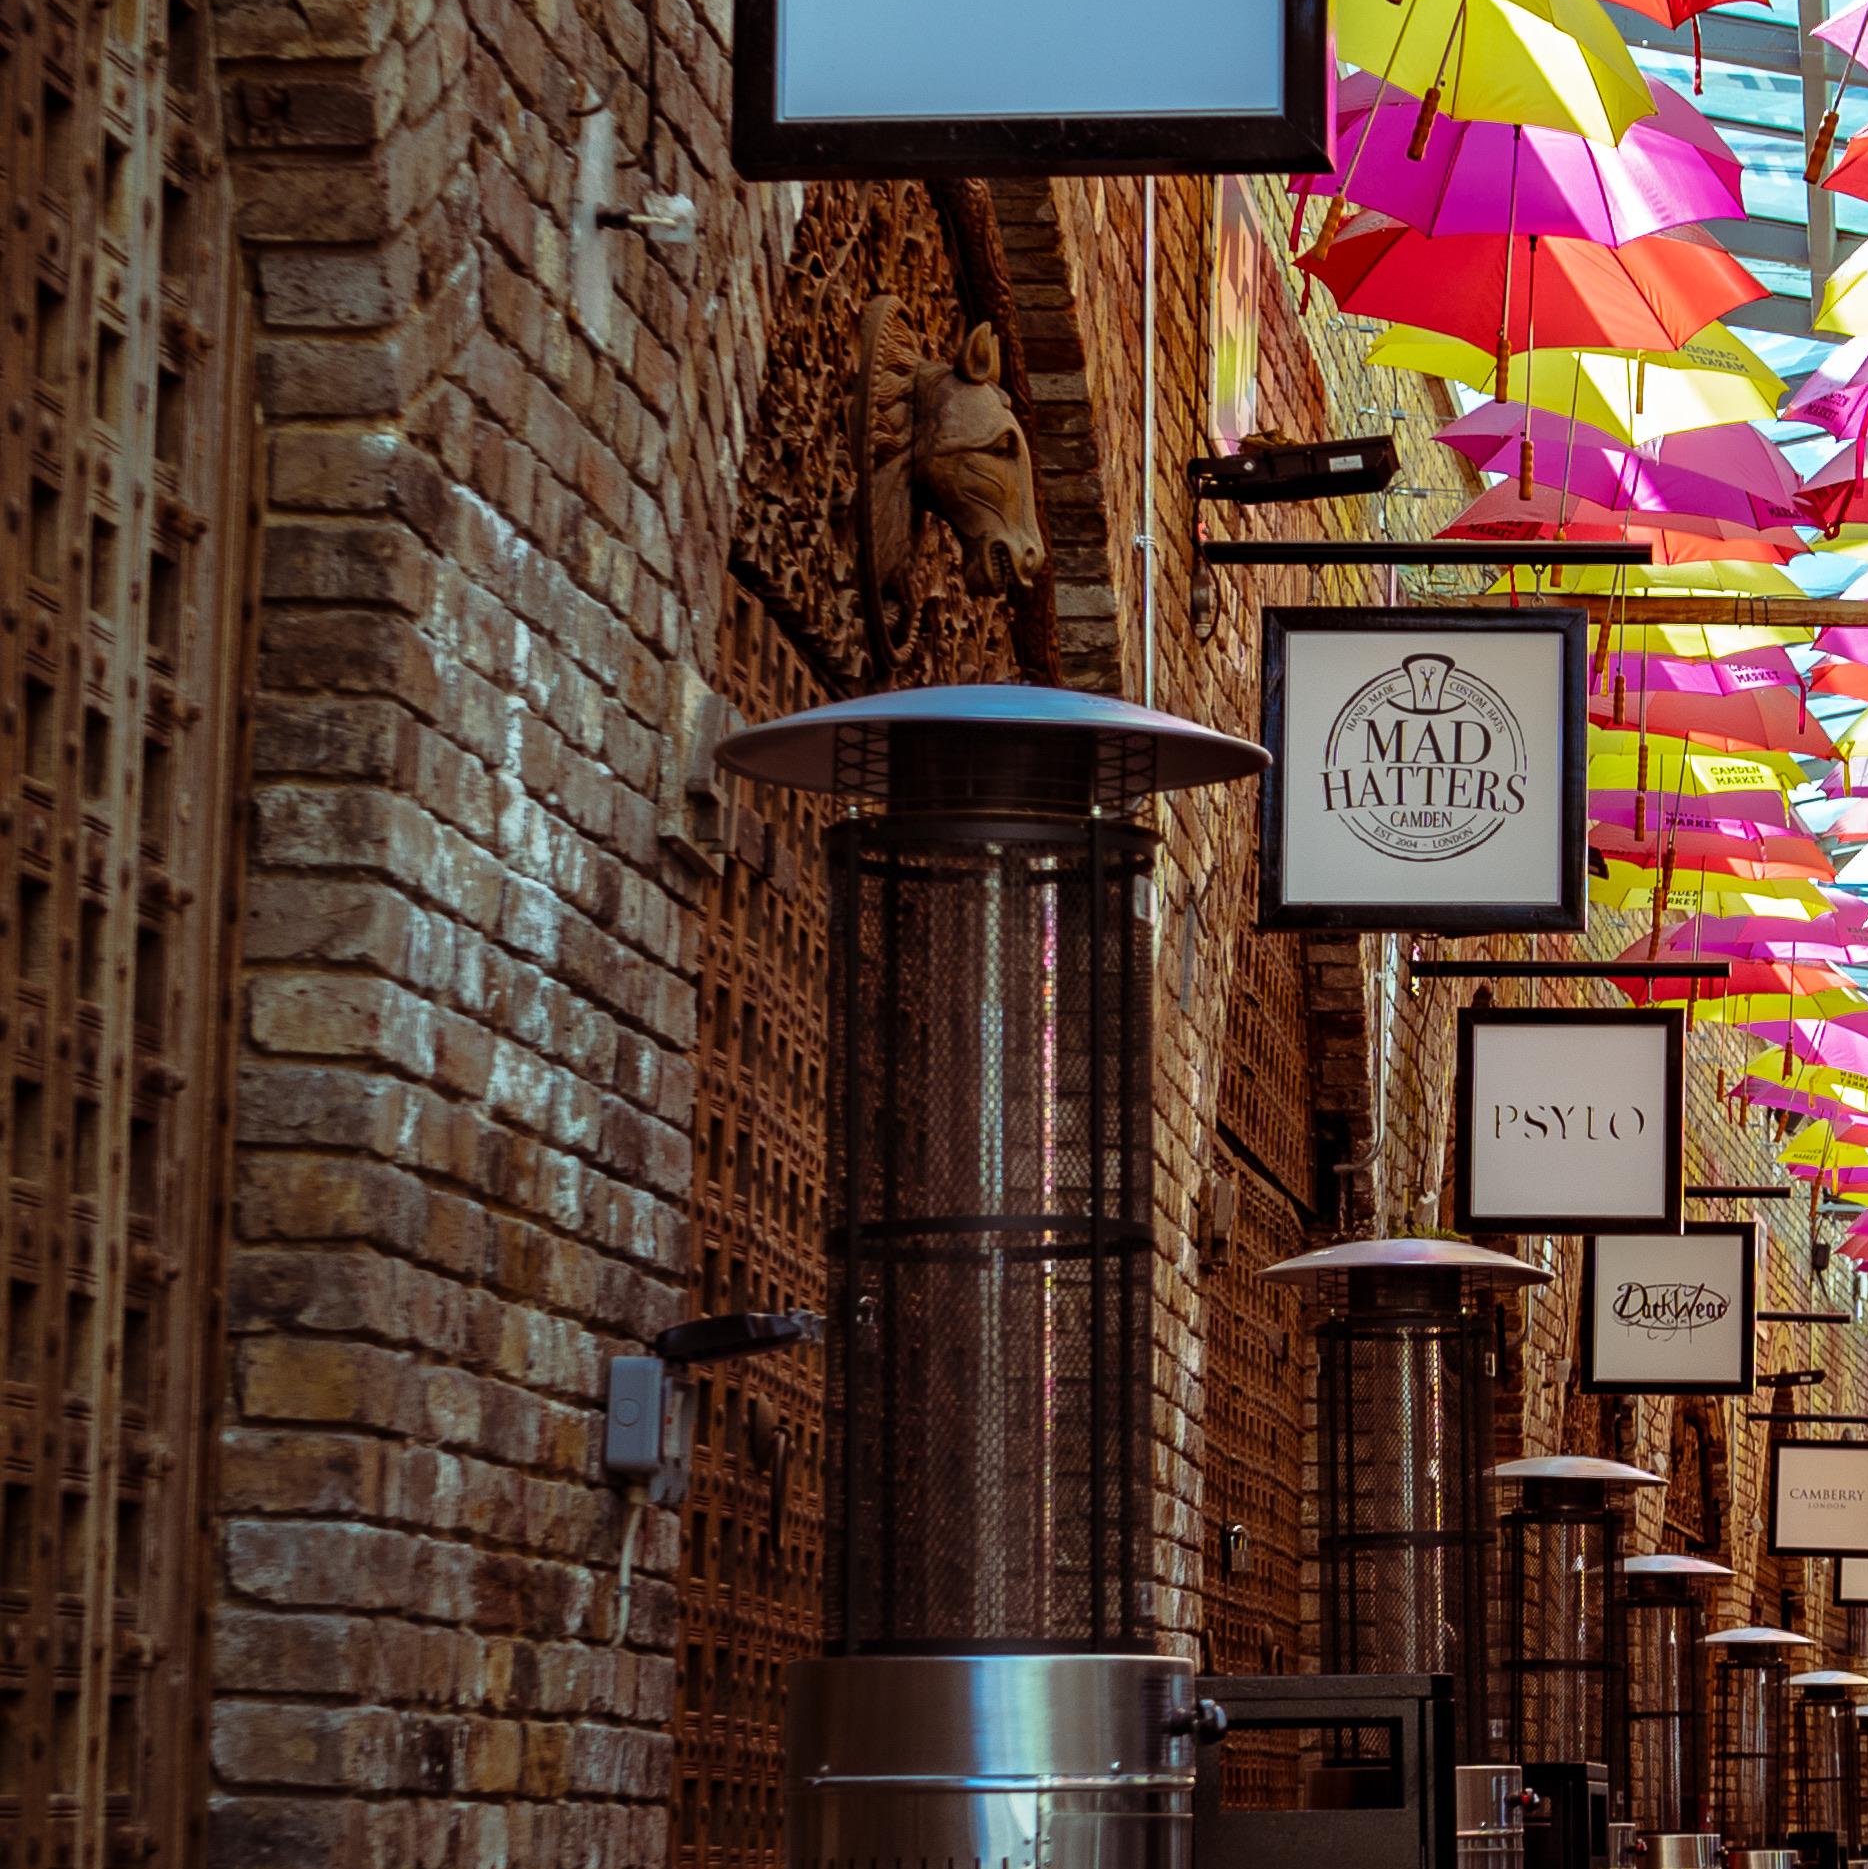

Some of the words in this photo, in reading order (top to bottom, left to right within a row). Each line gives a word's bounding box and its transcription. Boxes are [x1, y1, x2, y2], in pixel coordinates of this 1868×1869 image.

[1345, 704, 1368, 732] HAND
[1370, 684, 1396, 706] MADE
[1449, 681, 1488, 713] CUSTOM
[1486, 708, 1506, 735] HATS
[1361, 718, 1492, 764] MAD
[1710, 765, 1761, 776] CAMDEN
[1715, 775, 1766, 786] MARKET
[1319, 766, 1528, 815] HATTERS
[1390, 811, 1453, 829] CAMDEN
[1373, 826, 1391, 841] EST
[1395, 838, 1418, 849] 2004
[1432, 826, 1474, 849] LONDON
[1494, 1104, 1645, 1141] PSYLO
[1789, 1488, 1865, 1501] CAMBERRY
